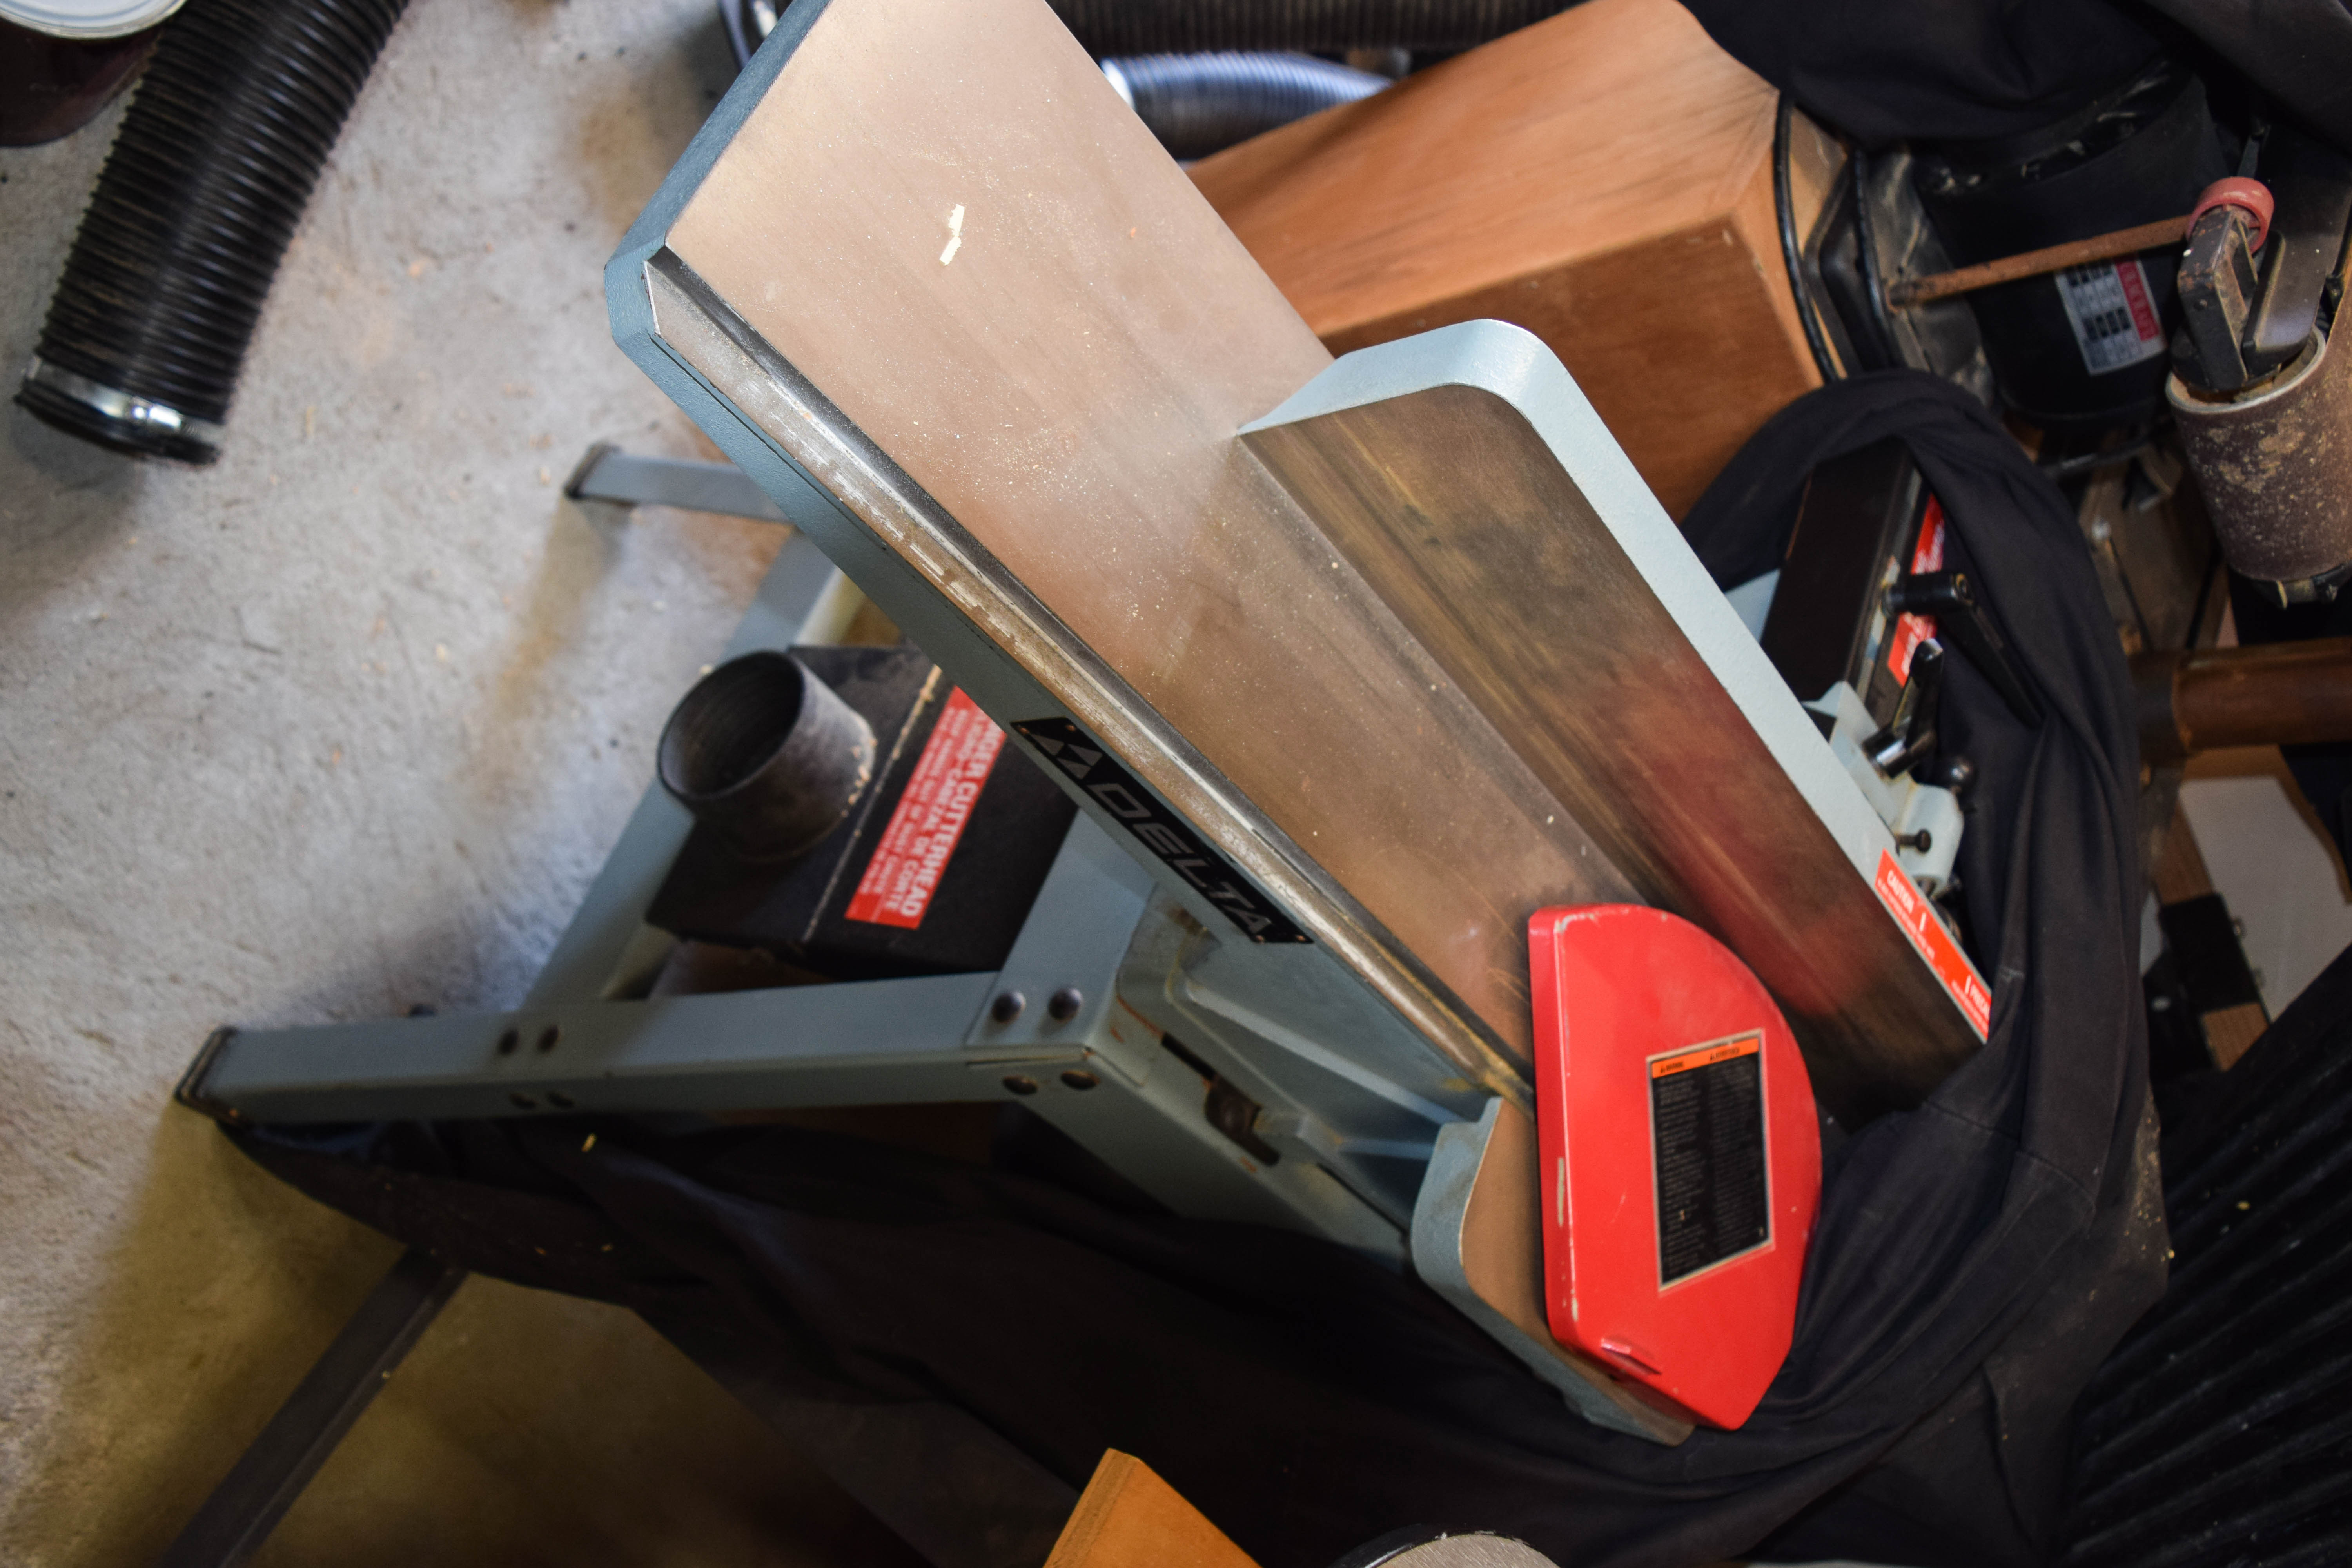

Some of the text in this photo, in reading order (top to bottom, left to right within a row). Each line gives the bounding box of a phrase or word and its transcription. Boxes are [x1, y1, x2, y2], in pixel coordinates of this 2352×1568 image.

[901, 782, 978, 916] CUTTERHEAD
[1089, 784, 1272, 935] DELTA
[1887, 869, 1914, 913] CAUTION
